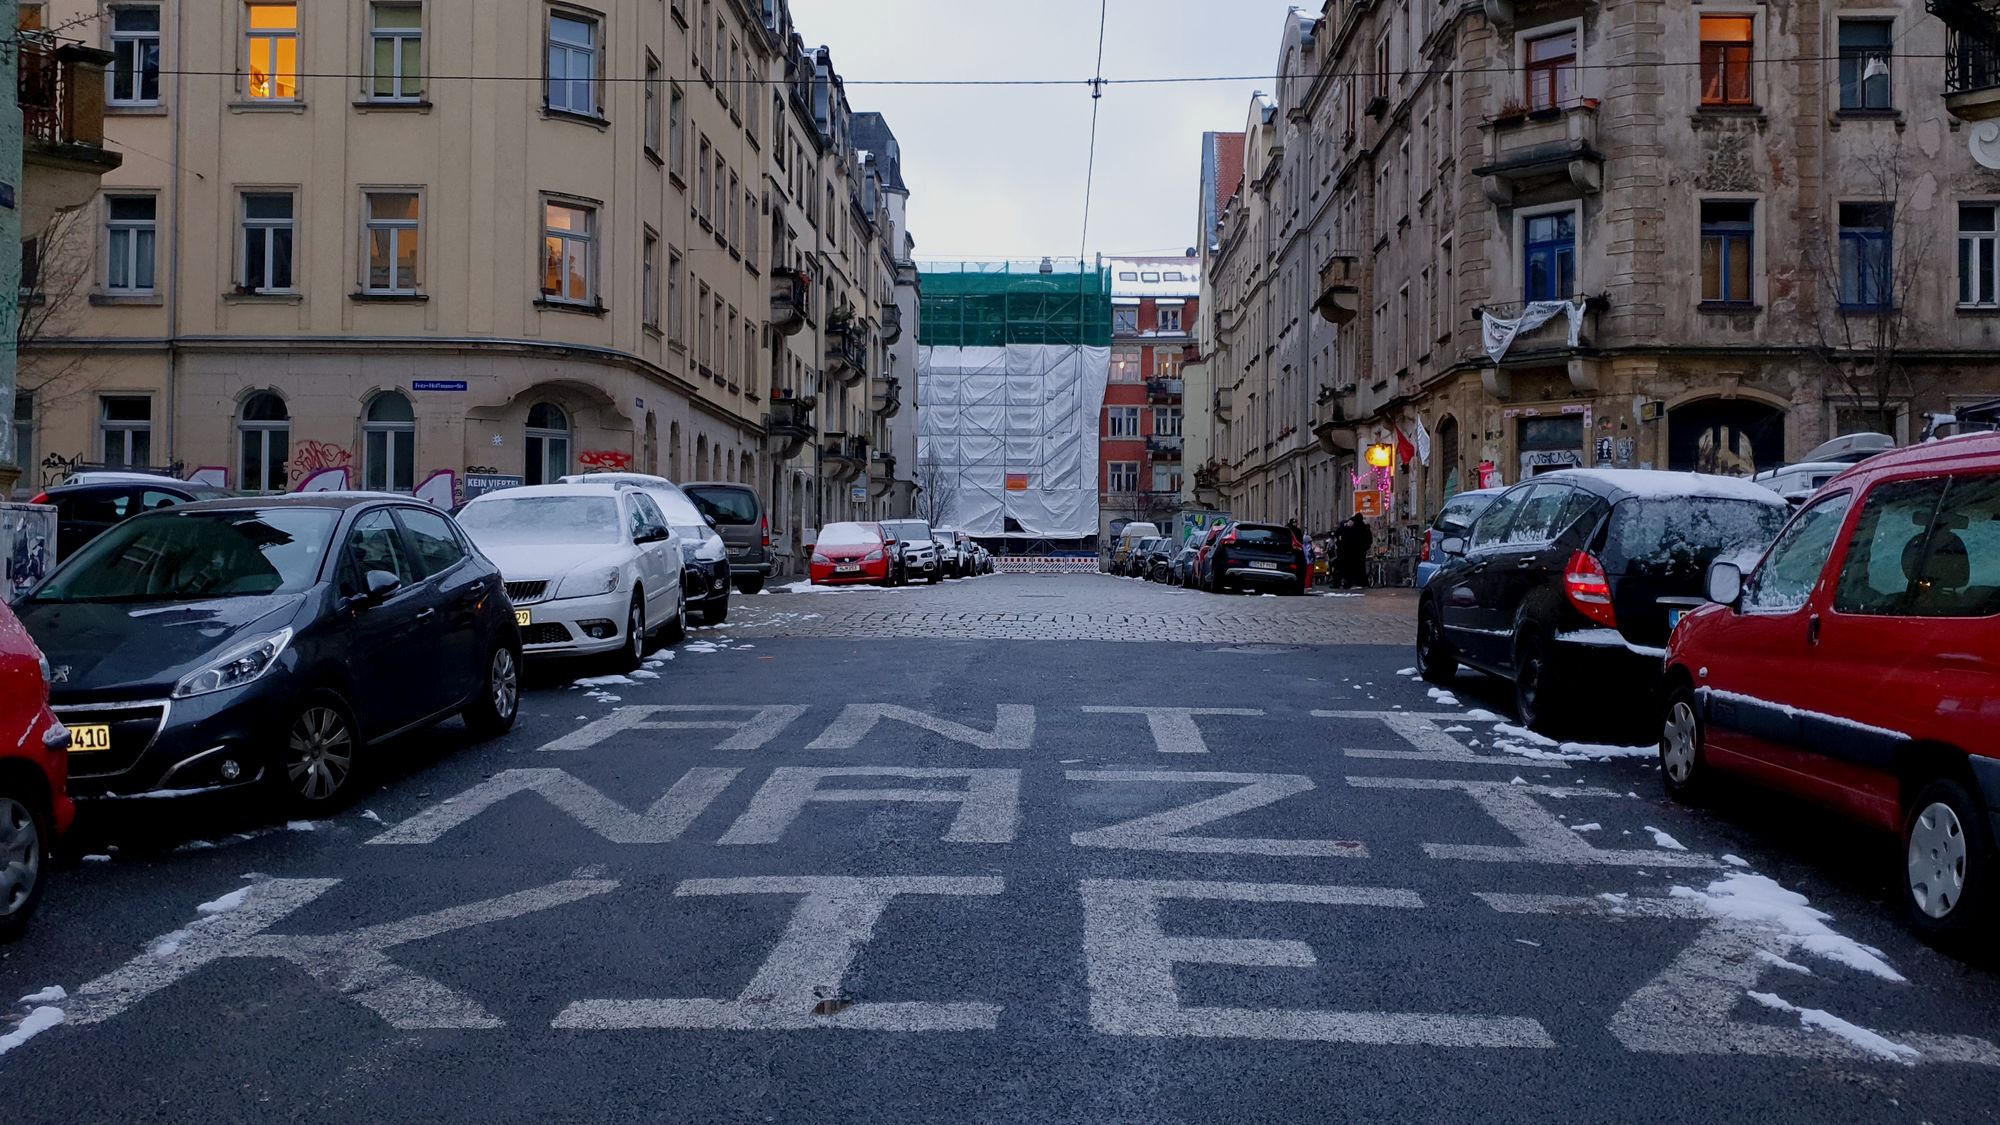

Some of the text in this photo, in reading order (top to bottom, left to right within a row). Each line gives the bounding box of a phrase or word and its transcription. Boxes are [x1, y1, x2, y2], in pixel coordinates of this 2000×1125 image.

[467, 478, 520, 488] KEIN VIERTEL
[539, 704, 1571, 769] ANTI
[365, 766, 1722, 868] NAZI
[60, 872, 2000, 1064] KIEZ
